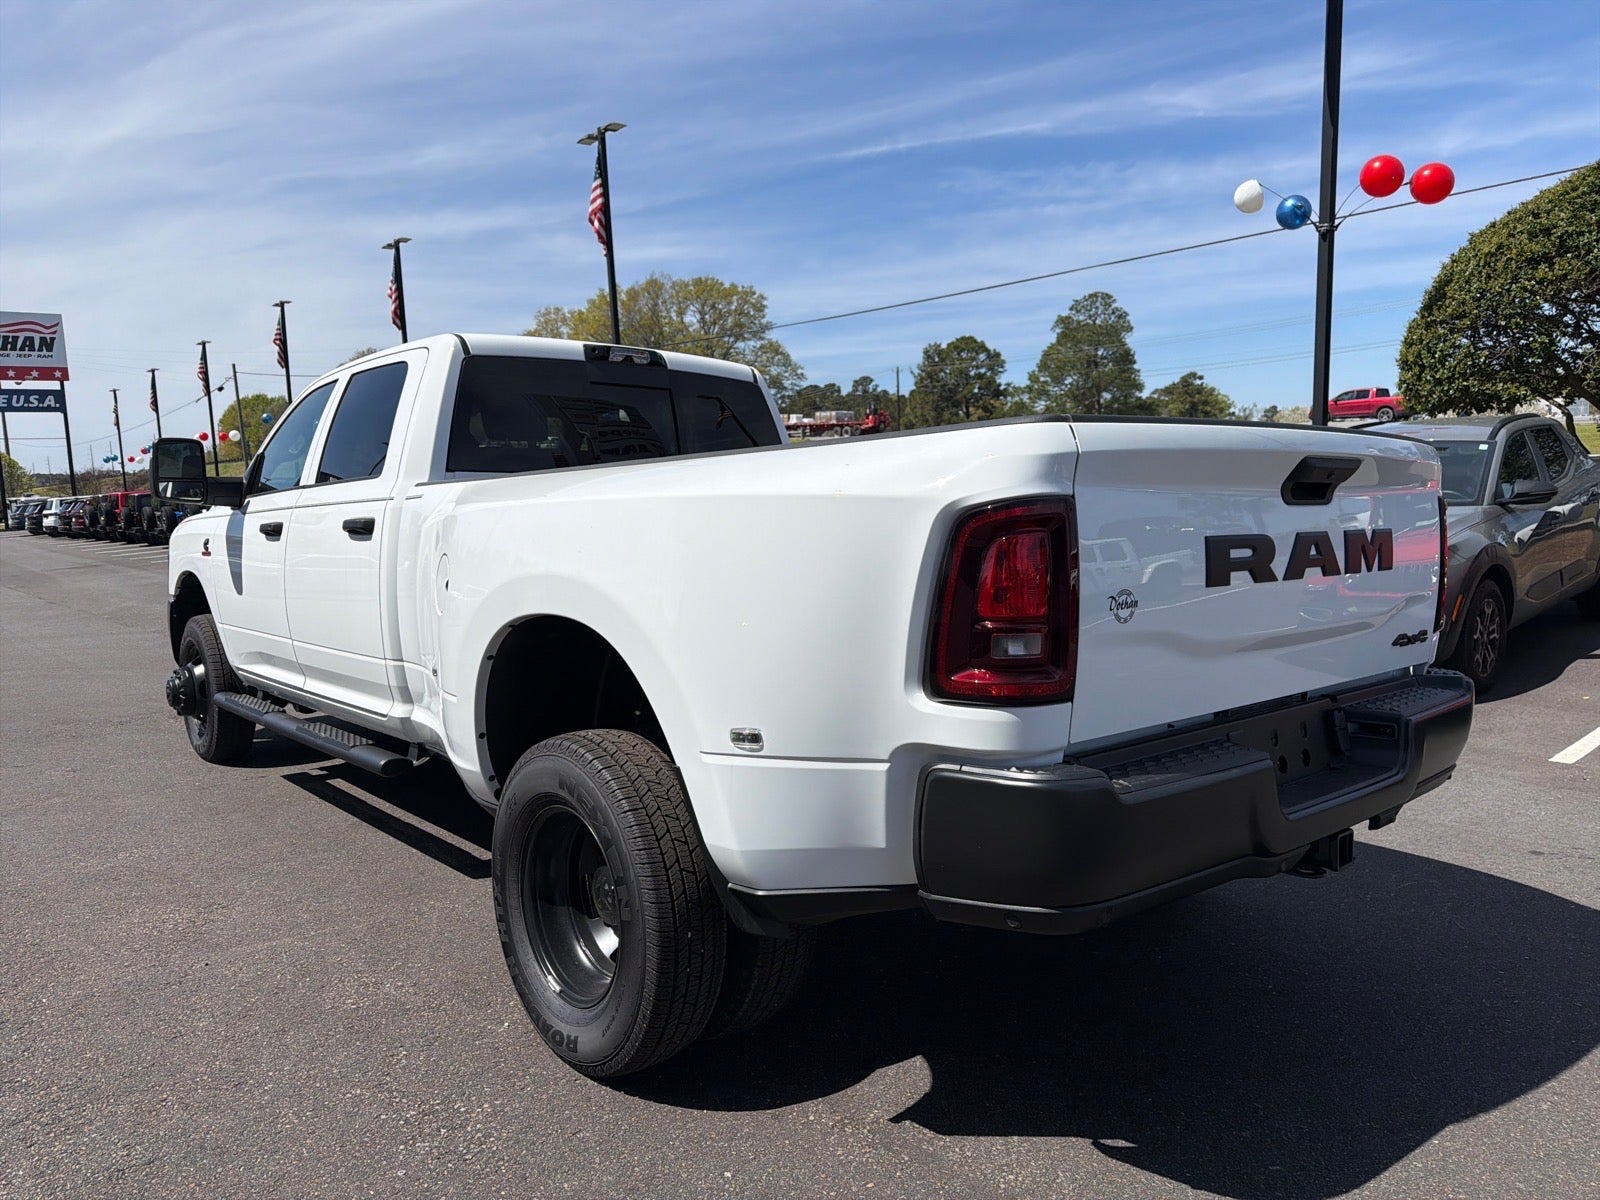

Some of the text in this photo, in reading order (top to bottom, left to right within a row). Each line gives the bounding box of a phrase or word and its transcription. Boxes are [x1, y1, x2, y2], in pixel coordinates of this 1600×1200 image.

[12, 395, 60, 407] U.S.A.
[1204, 528, 1393, 588] RAM
[1107, 595, 1138, 611] Dothan
